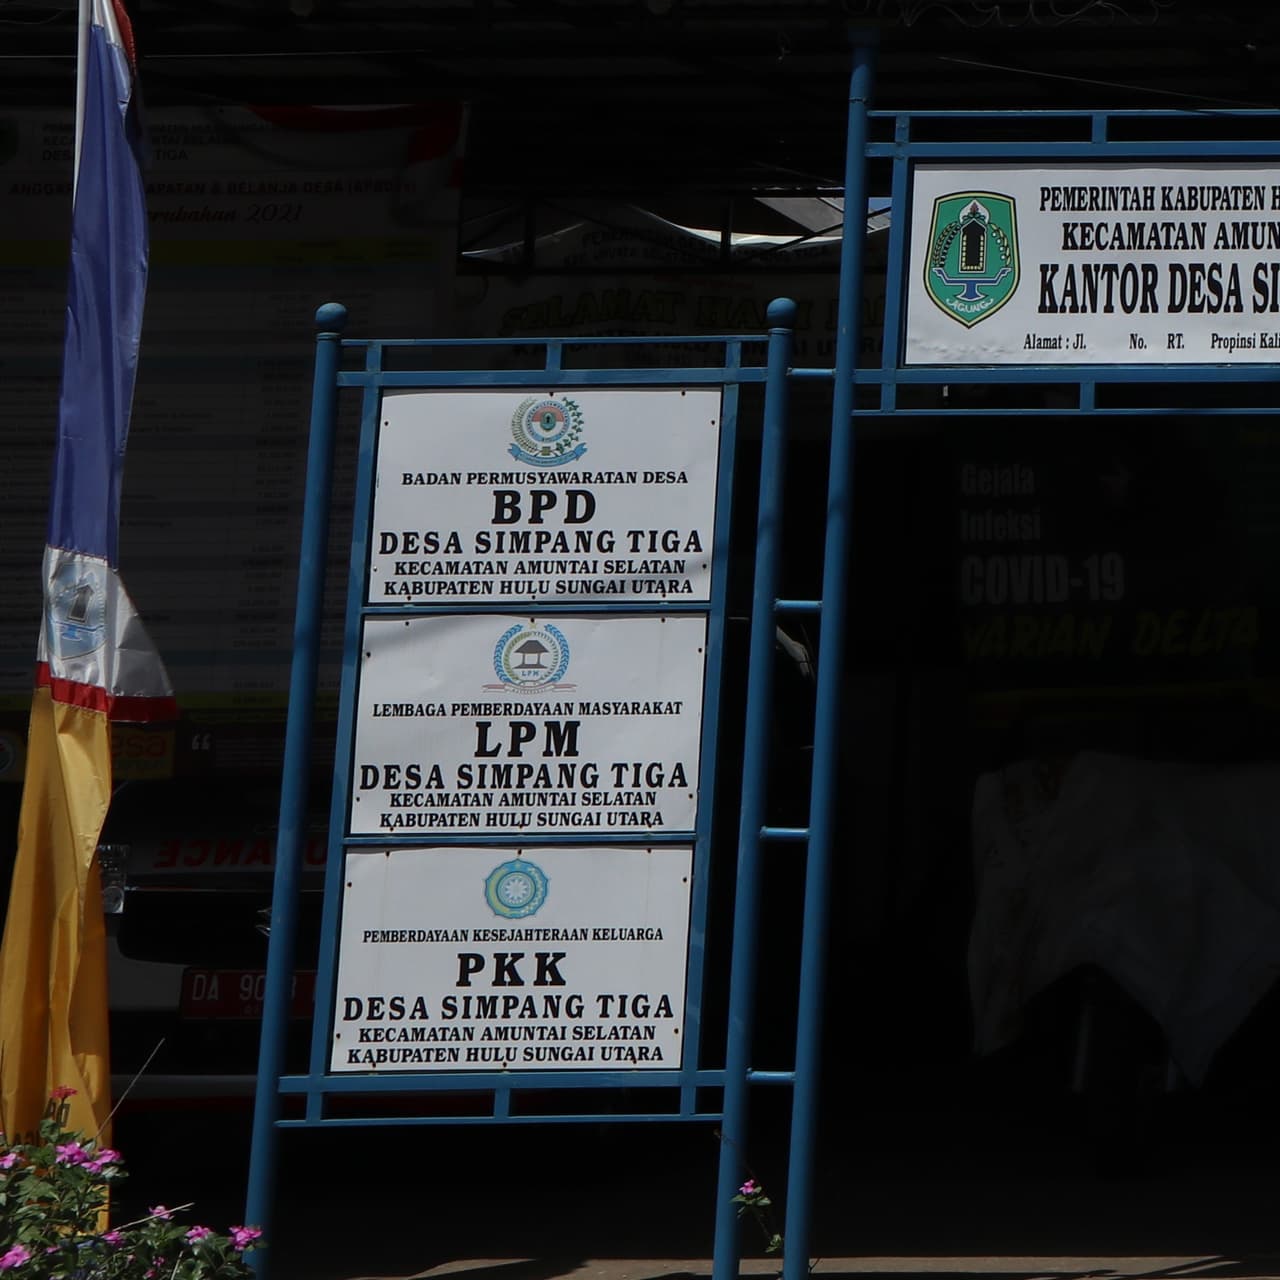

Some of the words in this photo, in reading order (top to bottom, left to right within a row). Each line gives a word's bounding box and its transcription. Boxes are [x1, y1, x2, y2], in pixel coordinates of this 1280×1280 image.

[1040, 186, 1156, 211] PEMERINTAH
[1160, 186, 1266, 211] KABUPATEN
[244, 202, 304, 224] 2021
[1061, 222, 1207, 251] KECAMATAN
[1037, 263, 1158, 314] KANTOR
[1168, 263, 1243, 314] DESA
[1023, 333, 1065, 350] Alamat
[1073, 333, 1087, 350] Jl.
[1129, 334, 1148, 350] No.
[1167, 334, 1185, 350] RT.
[1210, 332, 1257, 353] Propinsi
[402, 472, 461, 486] BADAN
[466, 471, 637, 485] PERMUSYAWARATAN
[642, 471, 688, 484] DESA
[960, 464, 1036, 497] Gejala
[491, 489, 597, 525] BPD
[959, 507, 1042, 542] Infeksi
[379, 531, 463, 555] DESA
[475, 530, 616, 554] SIMPANG
[627, 530, 703, 554] TIGA
[394, 561, 508, 576] KECAMATAN
[514, 560, 600, 575] AMUNTAI
[603, 559, 687, 574] SELATAN
[960, 551, 1126, 606] COVID-19
[384, 580, 494, 596] KABUPATEN
[500, 580, 550, 595] HULU
[555, 580, 626, 595] SUNGAI
[631, 579, 693, 594] UTARA
[962, 614, 1113, 658] VARIAN
[1133, 606, 1263, 657] DELTA
[372, 703, 447, 718] LEMBAGA
[450, 702, 574, 717] PEMBERDAYAAN
[578, 701, 684, 716] MASYARAKAT
[474, 721, 581, 757] LPM
[360, 765, 446, 790] DESA
[456, 764, 599, 789] SIMPANG
[610, 762, 688, 788] TIGA
[390, 793, 493, 808] KECAMATAN
[499, 792, 576, 807] AMUNTAI
[581, 791, 657, 807] SELATAN
[380, 812, 481, 828] KABUPATEN
[486, 812, 532, 827] HULU
[536, 812, 601, 827] SUNGAI
[606, 811, 664, 826] UTARA
[362, 930, 468, 943] PEMBERDAYAAN
[472, 929, 588, 942] KESEJAHTERAAN
[592, 928, 664, 941] KELUARGA
[456, 952, 567, 987] PKK
[192, 974, 219, 1002] DA
[343, 997, 430, 1021] DESA
[441, 995, 585, 1020] SIMPANG
[596, 994, 674, 1019] TIGA
[359, 1027, 475, 1043] KECAMATAN
[480, 1026, 567, 1041] AMUNTAI
[572, 1025, 656, 1041] SELATAN
[347, 1048, 459, 1064] KABUPATEN
[466, 1047, 518, 1062] HULU
[523, 1046, 595, 1062] SUNGAI
[600, 1046, 664, 1061] UTARA
